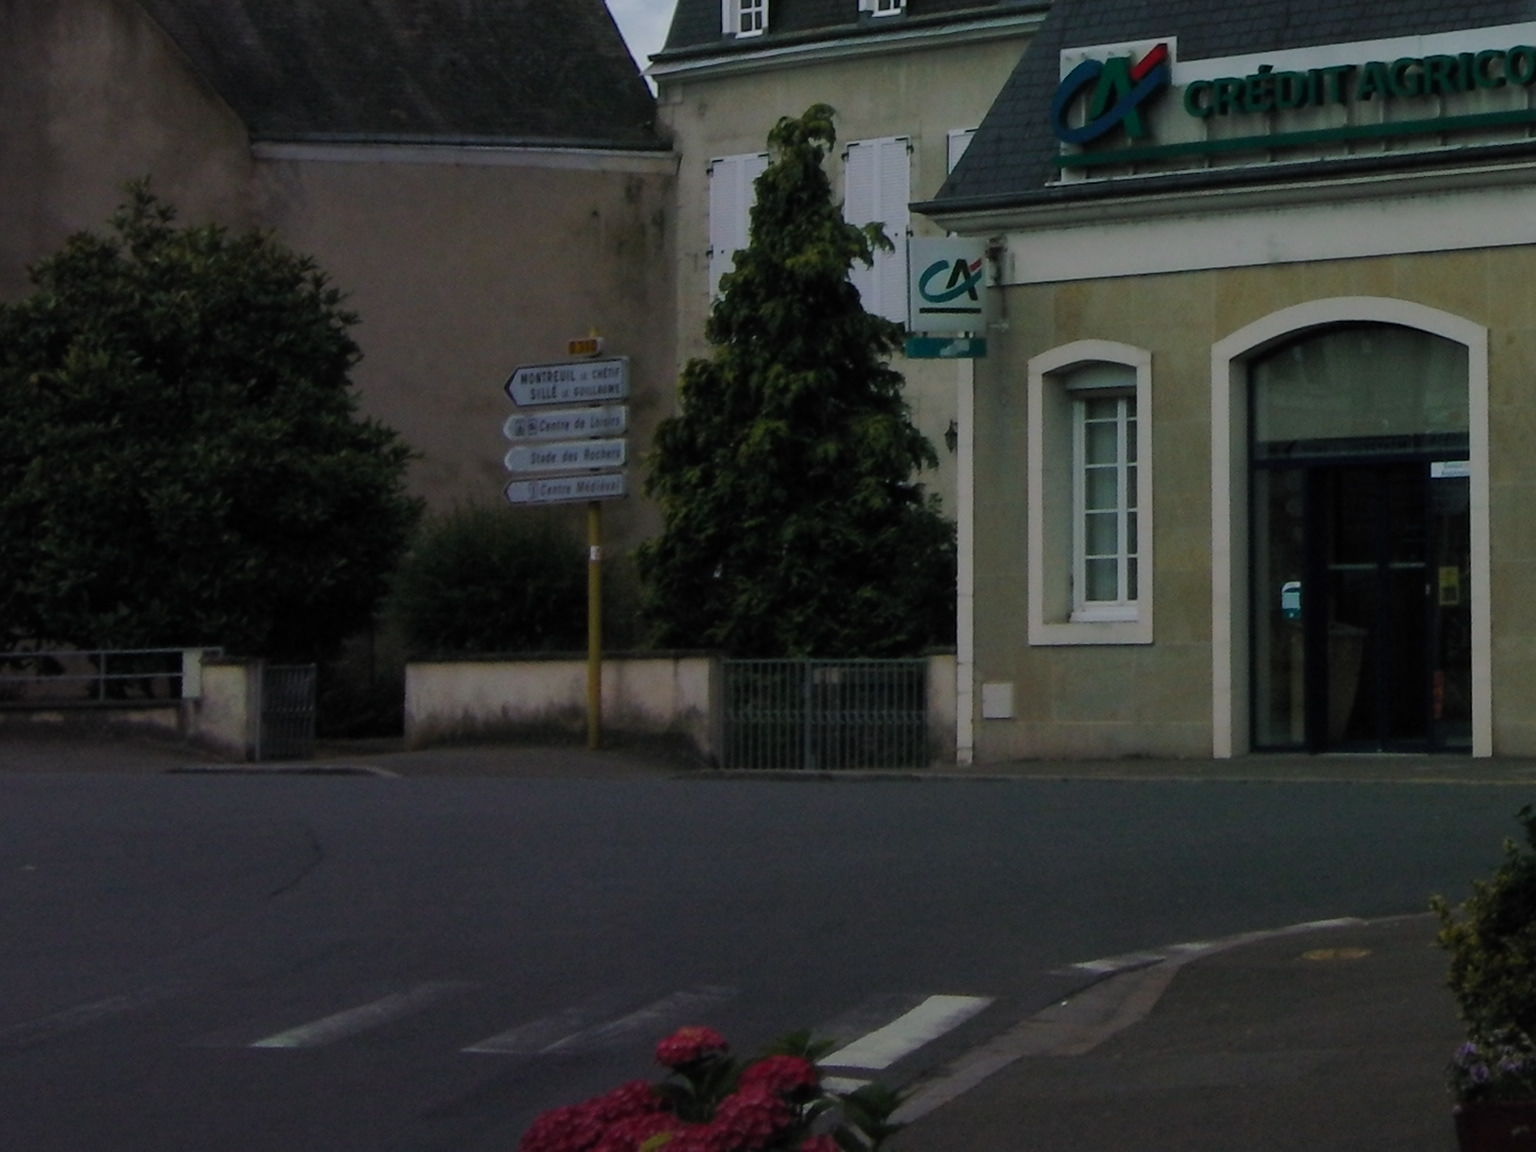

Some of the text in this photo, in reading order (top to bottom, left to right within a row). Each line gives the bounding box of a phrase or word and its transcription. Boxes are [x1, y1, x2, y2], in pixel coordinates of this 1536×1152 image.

[1183, 63, 1355, 119] CRÉDIT
[919, 258, 982, 303] CA
[520, 369, 576, 385] MONTREUIL
[530, 384, 557, 400] SILLÉ
[573, 383, 620, 397] GUILLAUME
[539, 415, 620, 432] Centre de Loisirs
[530, 448, 621, 464] Stade des Rochers
[540, 484, 571, 497] Centre
